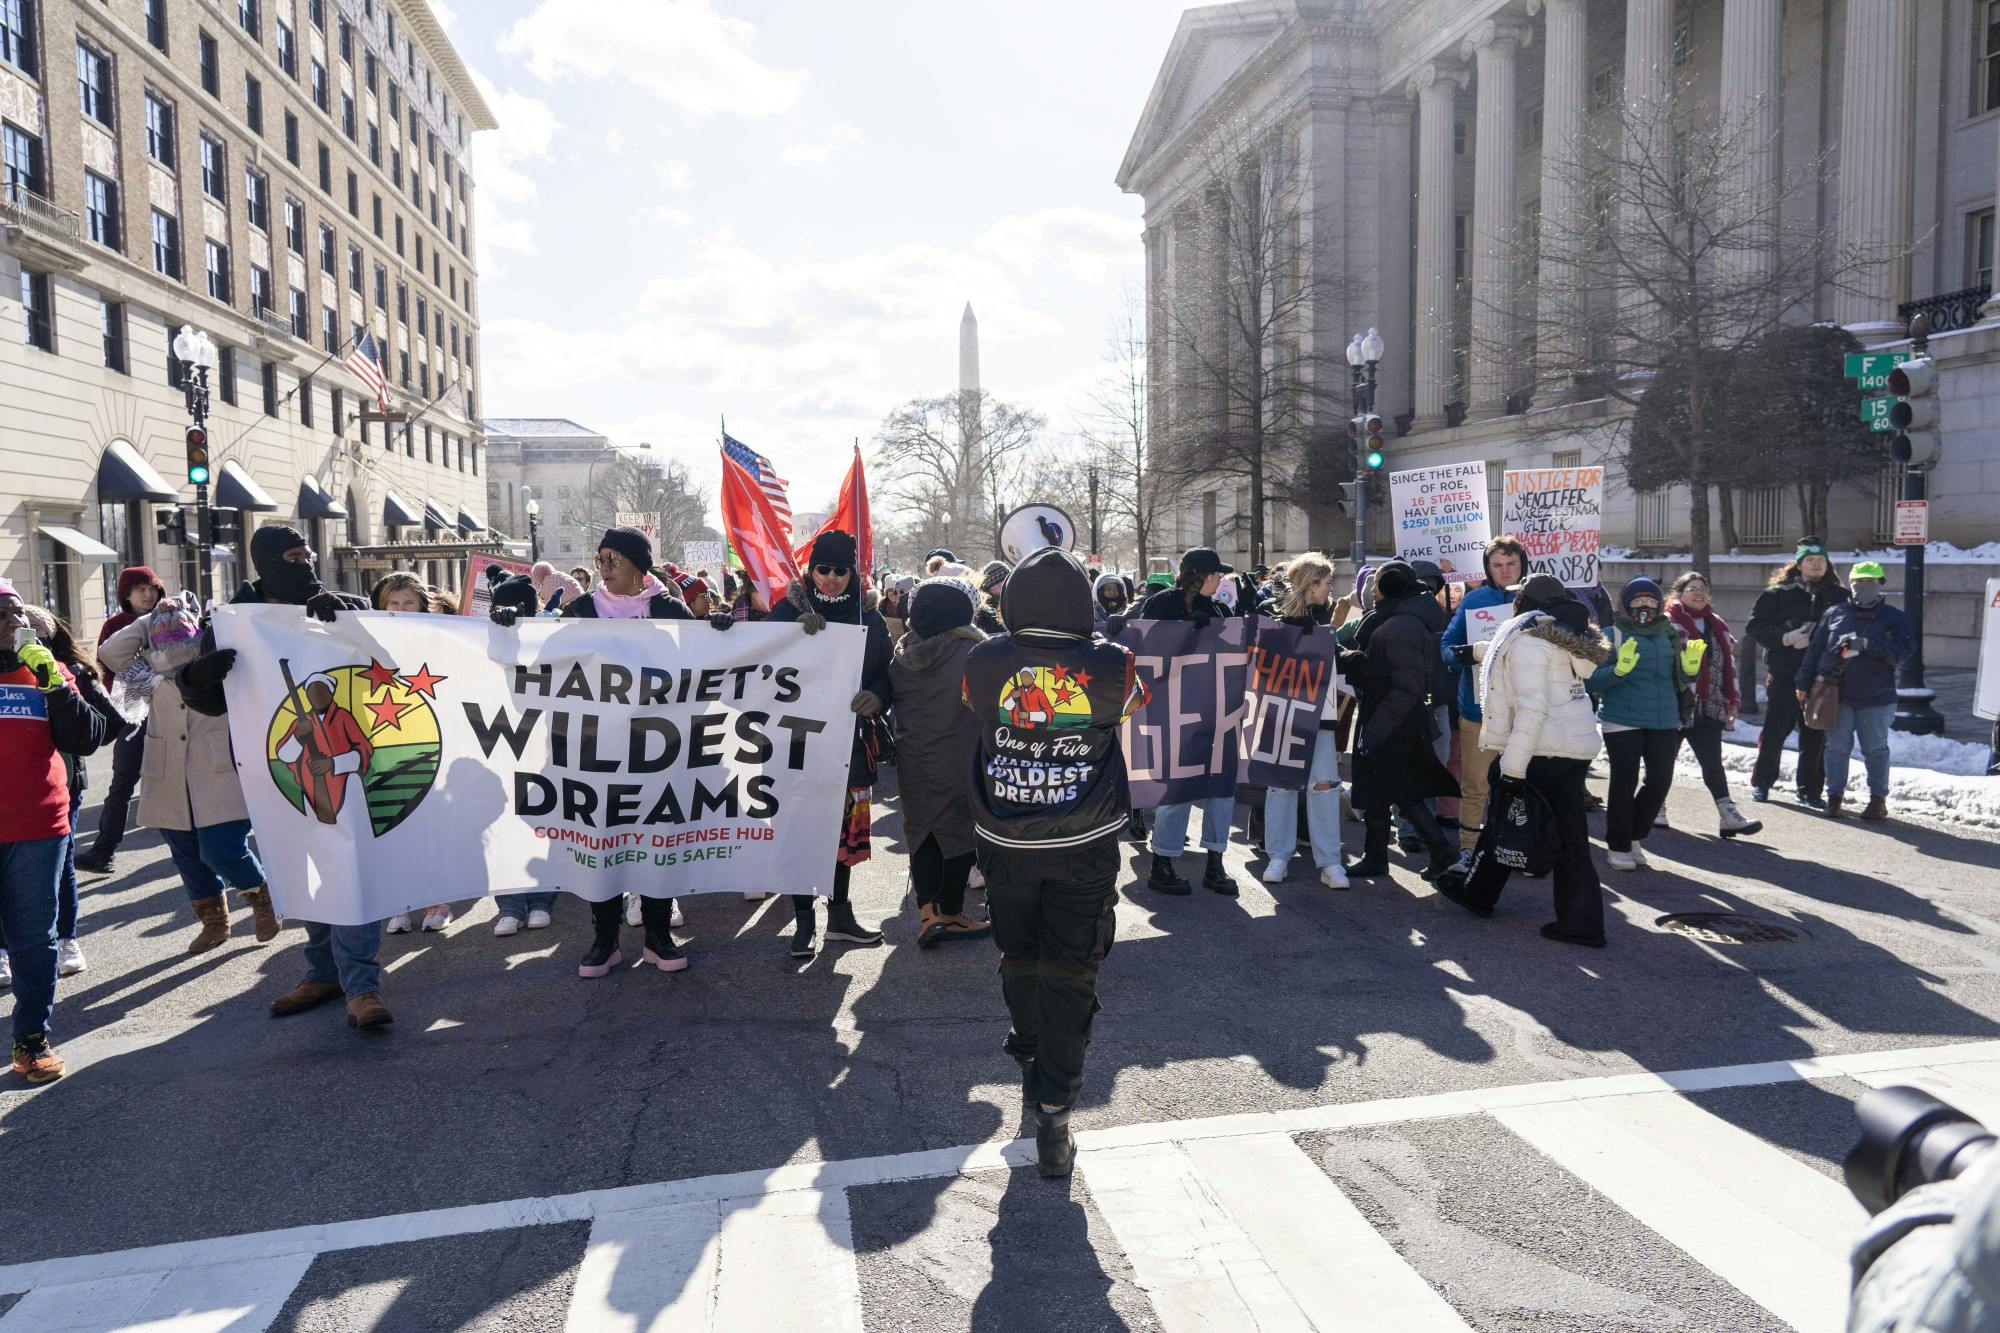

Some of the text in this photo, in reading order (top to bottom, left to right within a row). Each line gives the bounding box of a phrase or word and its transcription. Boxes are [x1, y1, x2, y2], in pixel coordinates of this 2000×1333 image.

[1862, 357, 1876, 374] F
[1871, 400, 1887, 416] 15
[1874, 417, 1891, 429] 60
[1391, 465, 1484, 485] SINCE THE FALL
[1505, 469, 1601, 496] JUSTICE FOR
[1420, 480, 1468, 494] OF ROE,
[1411, 491, 1472, 507] 16 STATES
[619, 512, 660, 524] KEEP YOUR
[1404, 501, 1480, 518] HAVE GIVEN
[1503, 503, 1600, 522] ALVAREZ ESTRADA
[1402, 512, 1483, 530] $250 MILLION
[1523, 517, 1573, 533] GLICK
[1435, 535, 1451, 544] TO
[1563, 530, 1600, 544] DEATH
[686, 550, 722, 563] CERVIX
[1403, 541, 1486, 558] FAKE CLINICS
[1560, 553, 1597, 583] SB8
[514, 660, 802, 706] HARRIET'S
[1247, 645, 1325, 703] THAN
[1122, 652, 1250, 784] GER
[461, 701, 827, 774] WILDEST
[995, 726, 1093, 758] One of Five
[987, 761, 1093, 787] WILDEST
[514, 771, 779, 829] DREAMS
[994, 780, 1077, 804] DREAMS
[534, 826, 775, 851] COMMUNITY DEFENSE HUB
[566, 845, 742, 869] "WE KEEP US SAFE!"
